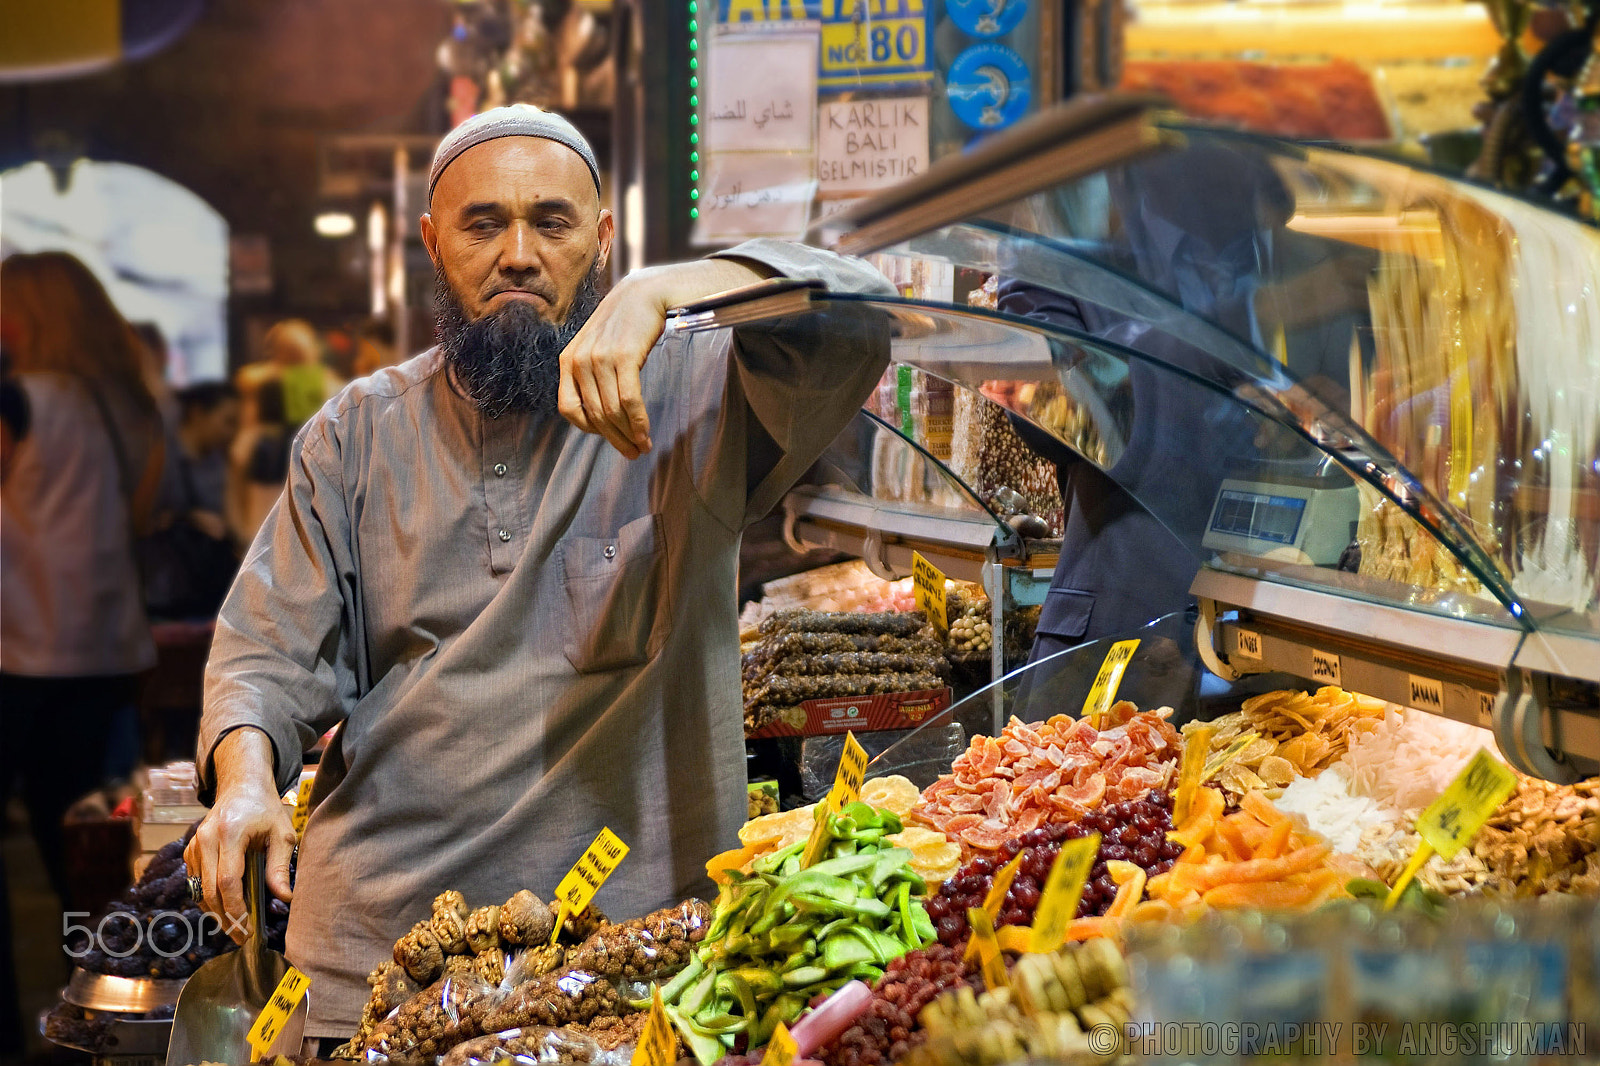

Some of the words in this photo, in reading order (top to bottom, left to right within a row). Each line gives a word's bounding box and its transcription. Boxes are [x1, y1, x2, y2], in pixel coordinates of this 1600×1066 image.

[871, 25, 919, 62] 80
[828, 102, 919, 129] KARLIK
[846, 132, 897, 154] BALI
